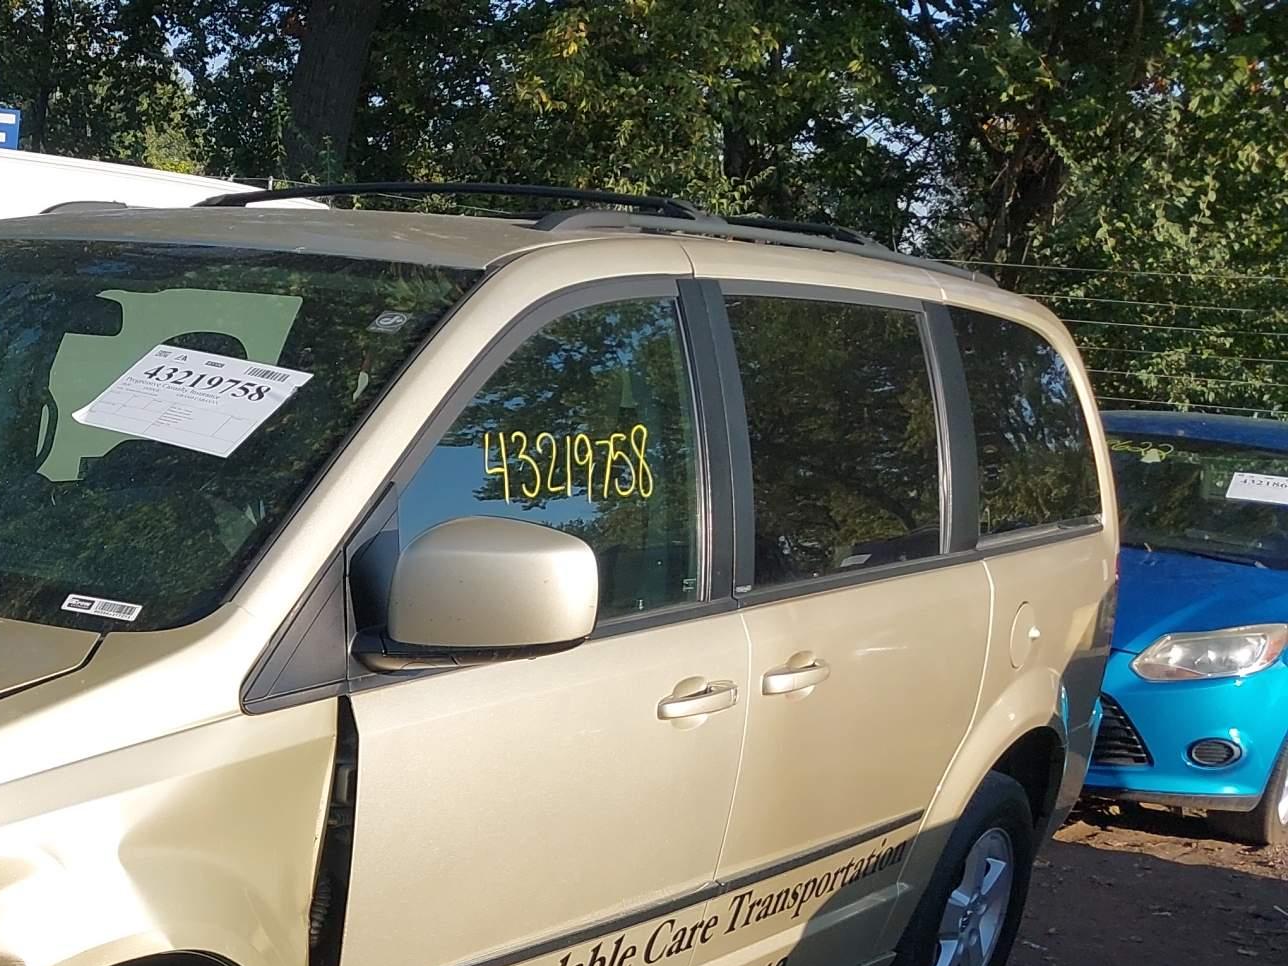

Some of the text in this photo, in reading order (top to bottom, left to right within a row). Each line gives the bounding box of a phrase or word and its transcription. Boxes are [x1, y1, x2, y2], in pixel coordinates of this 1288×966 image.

[143, 364, 272, 402] 43219758
[484, 424, 653, 504] 43219758
[643, 912, 719, 965] Care
[724, 838, 908, 935] Transportation
